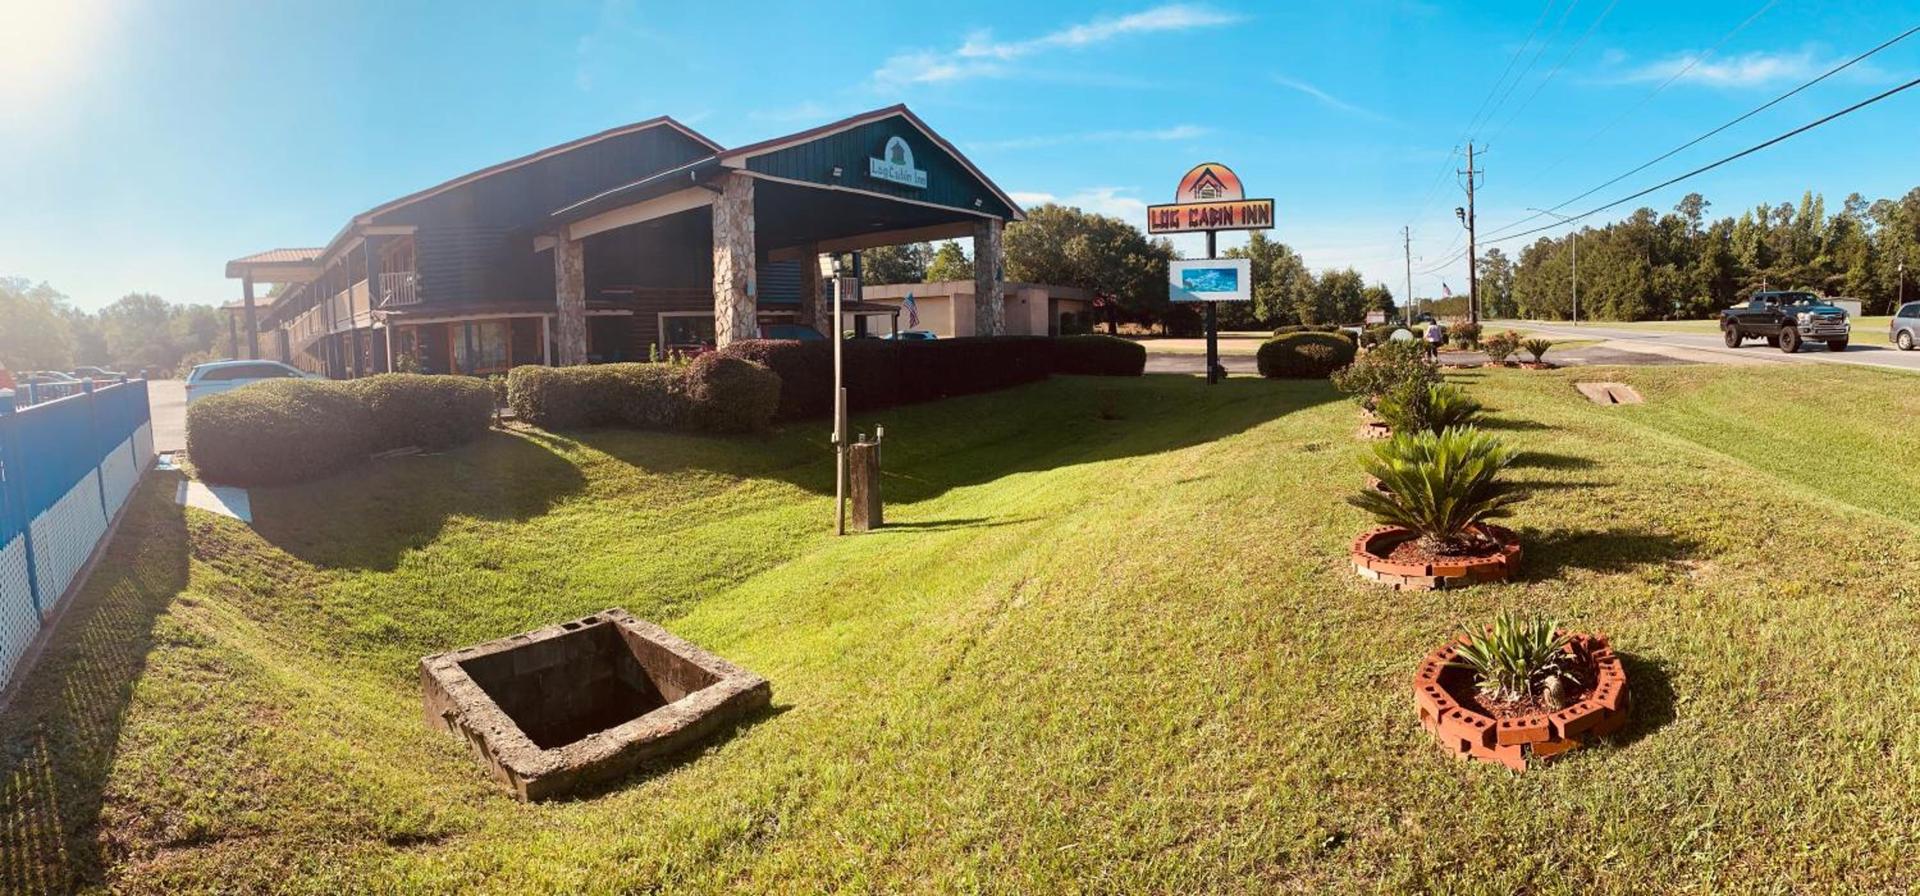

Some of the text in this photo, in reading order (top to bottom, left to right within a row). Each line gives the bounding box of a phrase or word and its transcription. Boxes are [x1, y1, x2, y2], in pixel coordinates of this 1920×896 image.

[871, 159, 926, 185] Log Cabin Inn
[1151, 203, 1269, 230] LOG CABIN INN
